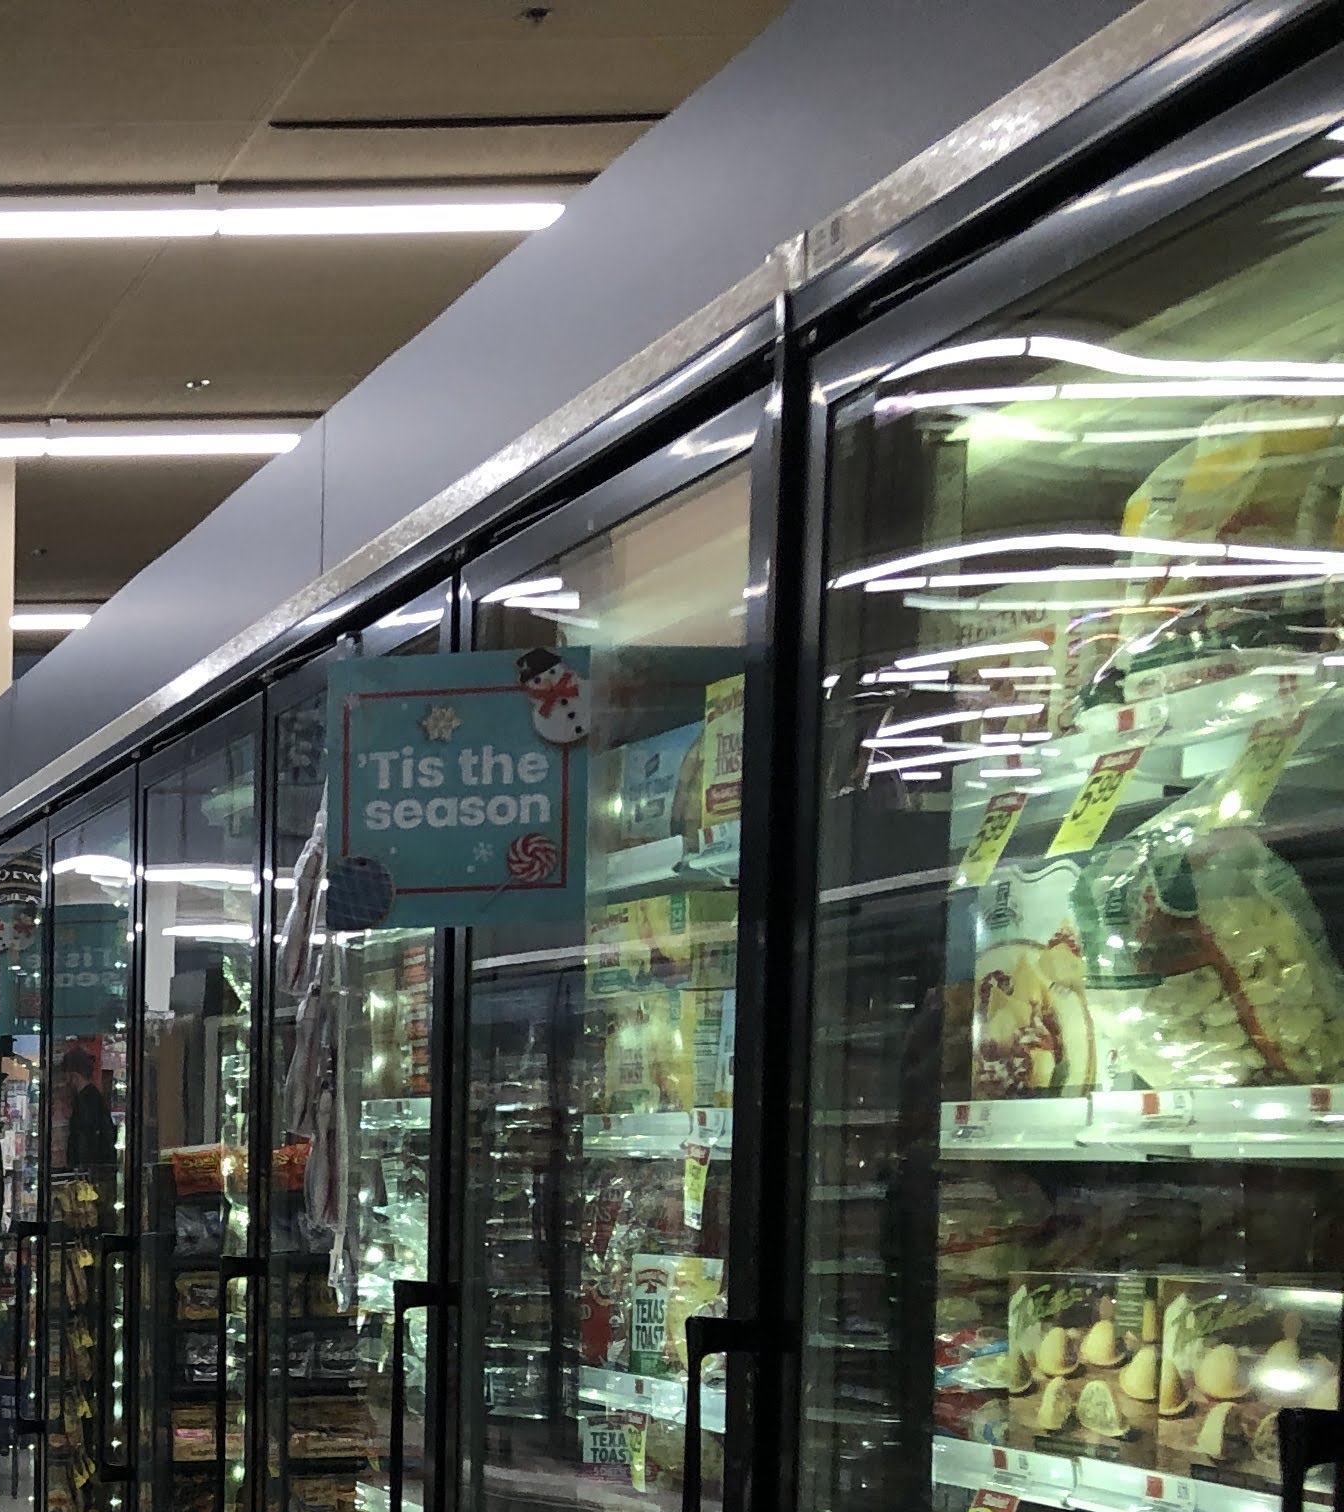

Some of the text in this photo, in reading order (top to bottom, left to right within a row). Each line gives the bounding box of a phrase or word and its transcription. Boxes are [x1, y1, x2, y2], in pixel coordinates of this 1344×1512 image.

[458, 745, 550, 786] the
[365, 792, 551, 830] season
[635, 1298, 665, 1324] TEXAS
[635, 1325, 665, 1350] TOAST
[590, 1431, 628, 1448] TEXA
[590, 1447, 628, 1463] TOAS
